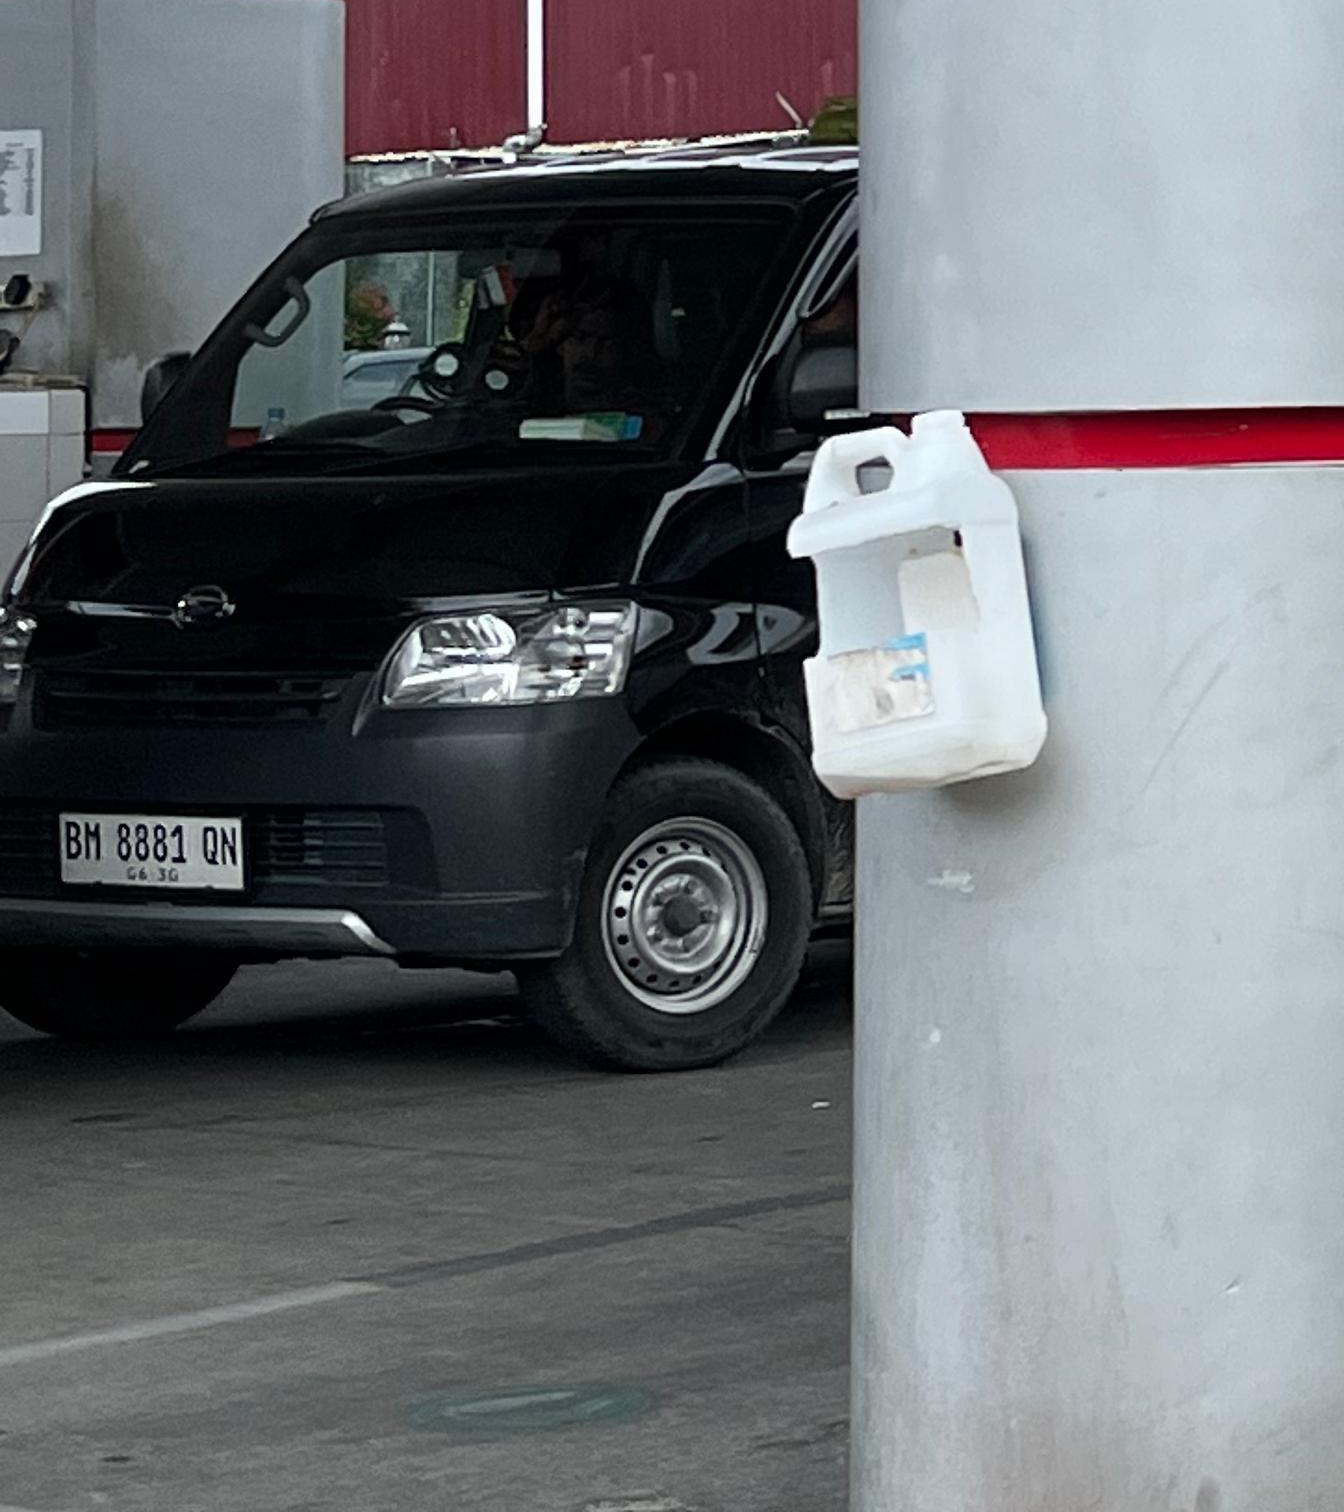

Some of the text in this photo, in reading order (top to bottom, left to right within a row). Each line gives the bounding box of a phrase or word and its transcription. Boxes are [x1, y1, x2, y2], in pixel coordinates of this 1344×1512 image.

[65, 821, 237, 865] BM 8881 QN
